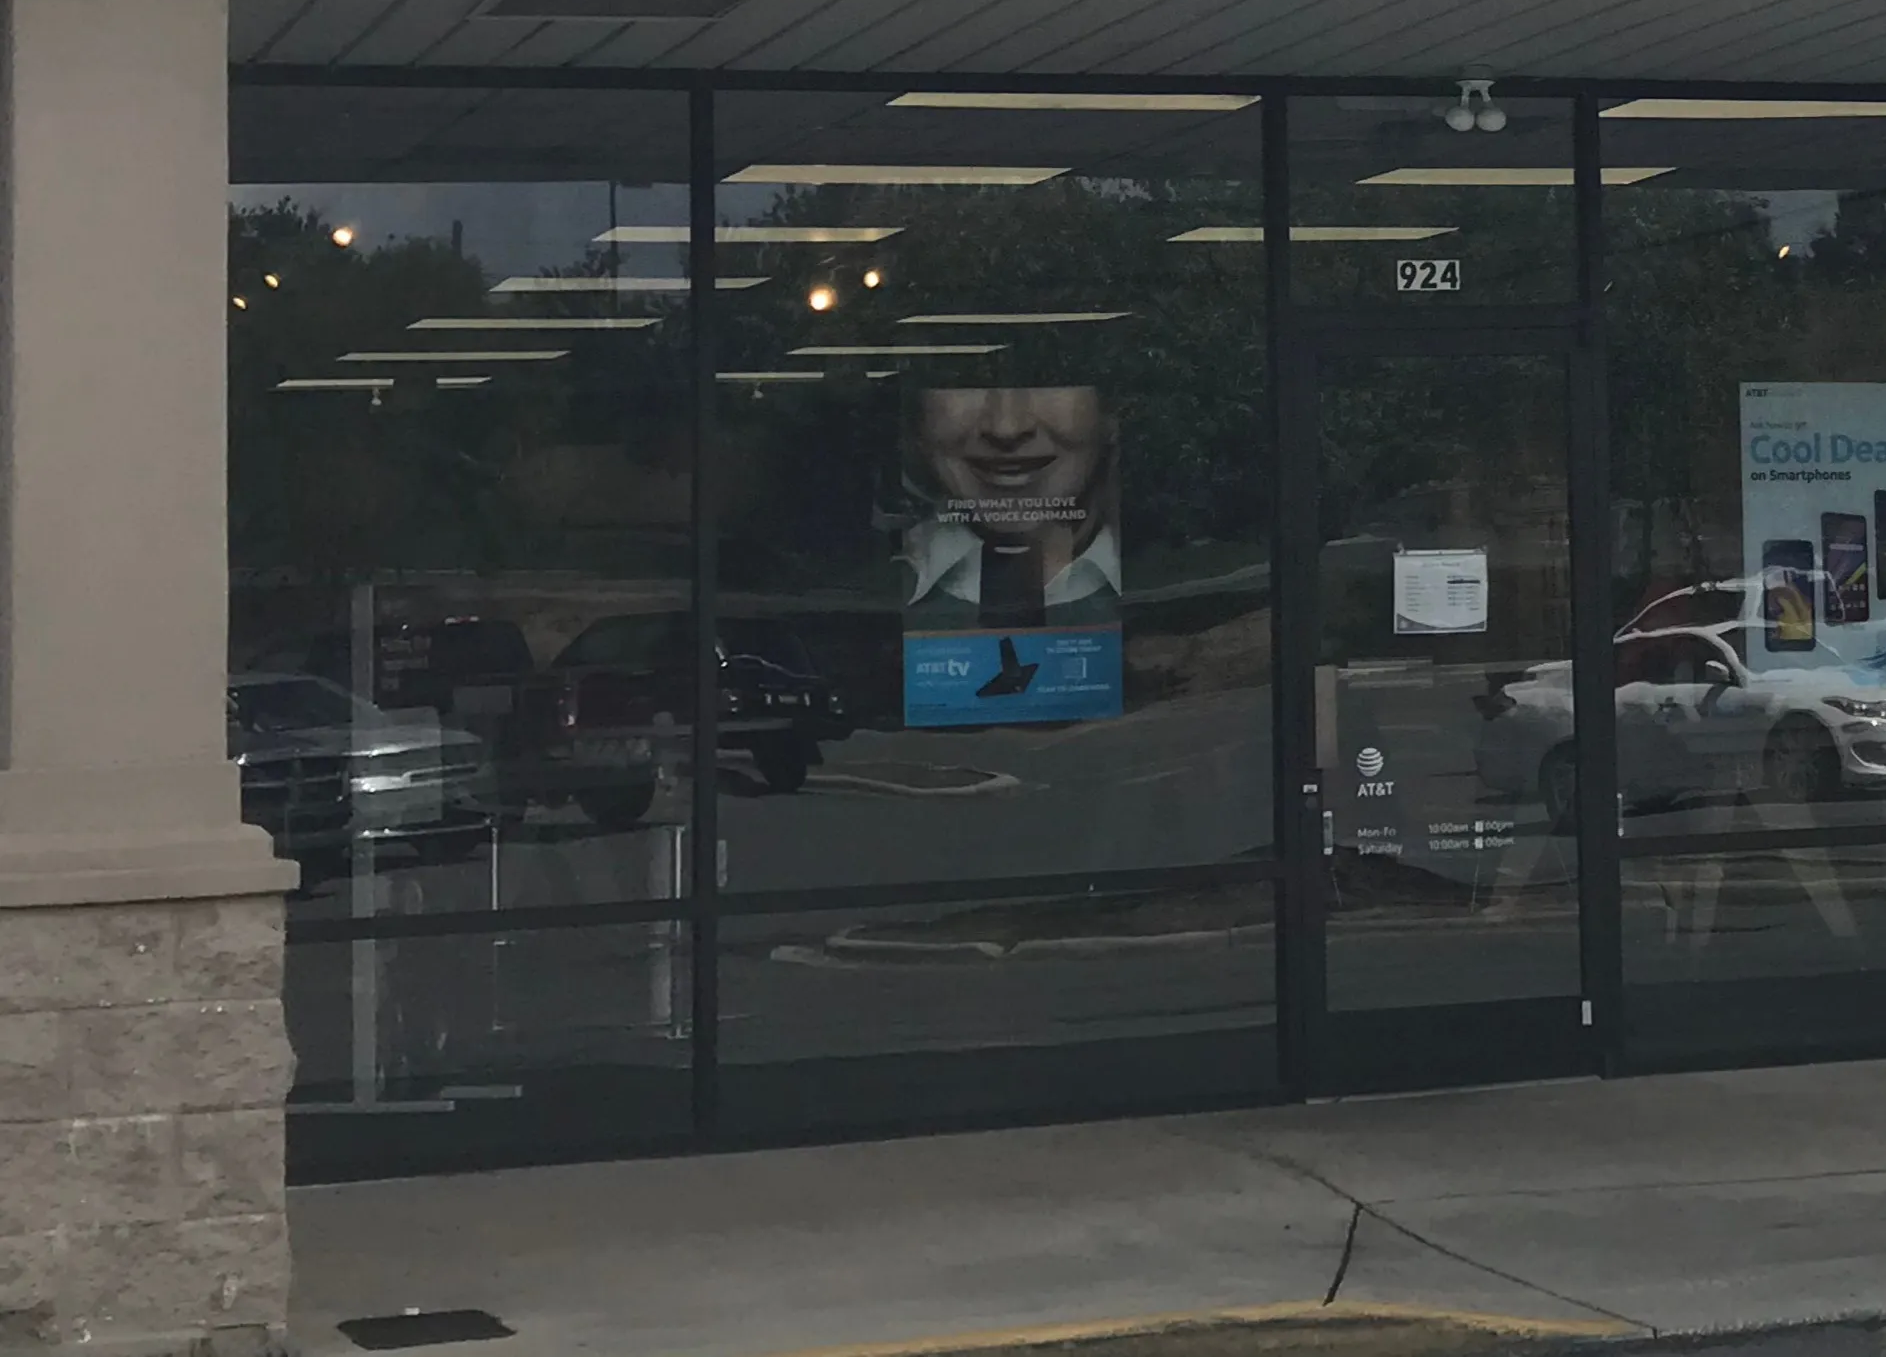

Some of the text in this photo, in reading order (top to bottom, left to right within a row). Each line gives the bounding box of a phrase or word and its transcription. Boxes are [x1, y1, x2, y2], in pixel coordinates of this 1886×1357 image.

[1400, 261, 1458, 288] 924
[1750, 432, 1821, 464] Cool
[1751, 469, 1852, 483] on Smartphones
[947, 496, 1076, 510] FIND WHAT YOU LOVE
[937, 509, 1087, 523] WITH A VOICE COMMAND
[948, 659, 970, 676] tv
[1357, 781, 1394, 797] AT&T
[1358, 842, 1403, 855] Saturday
